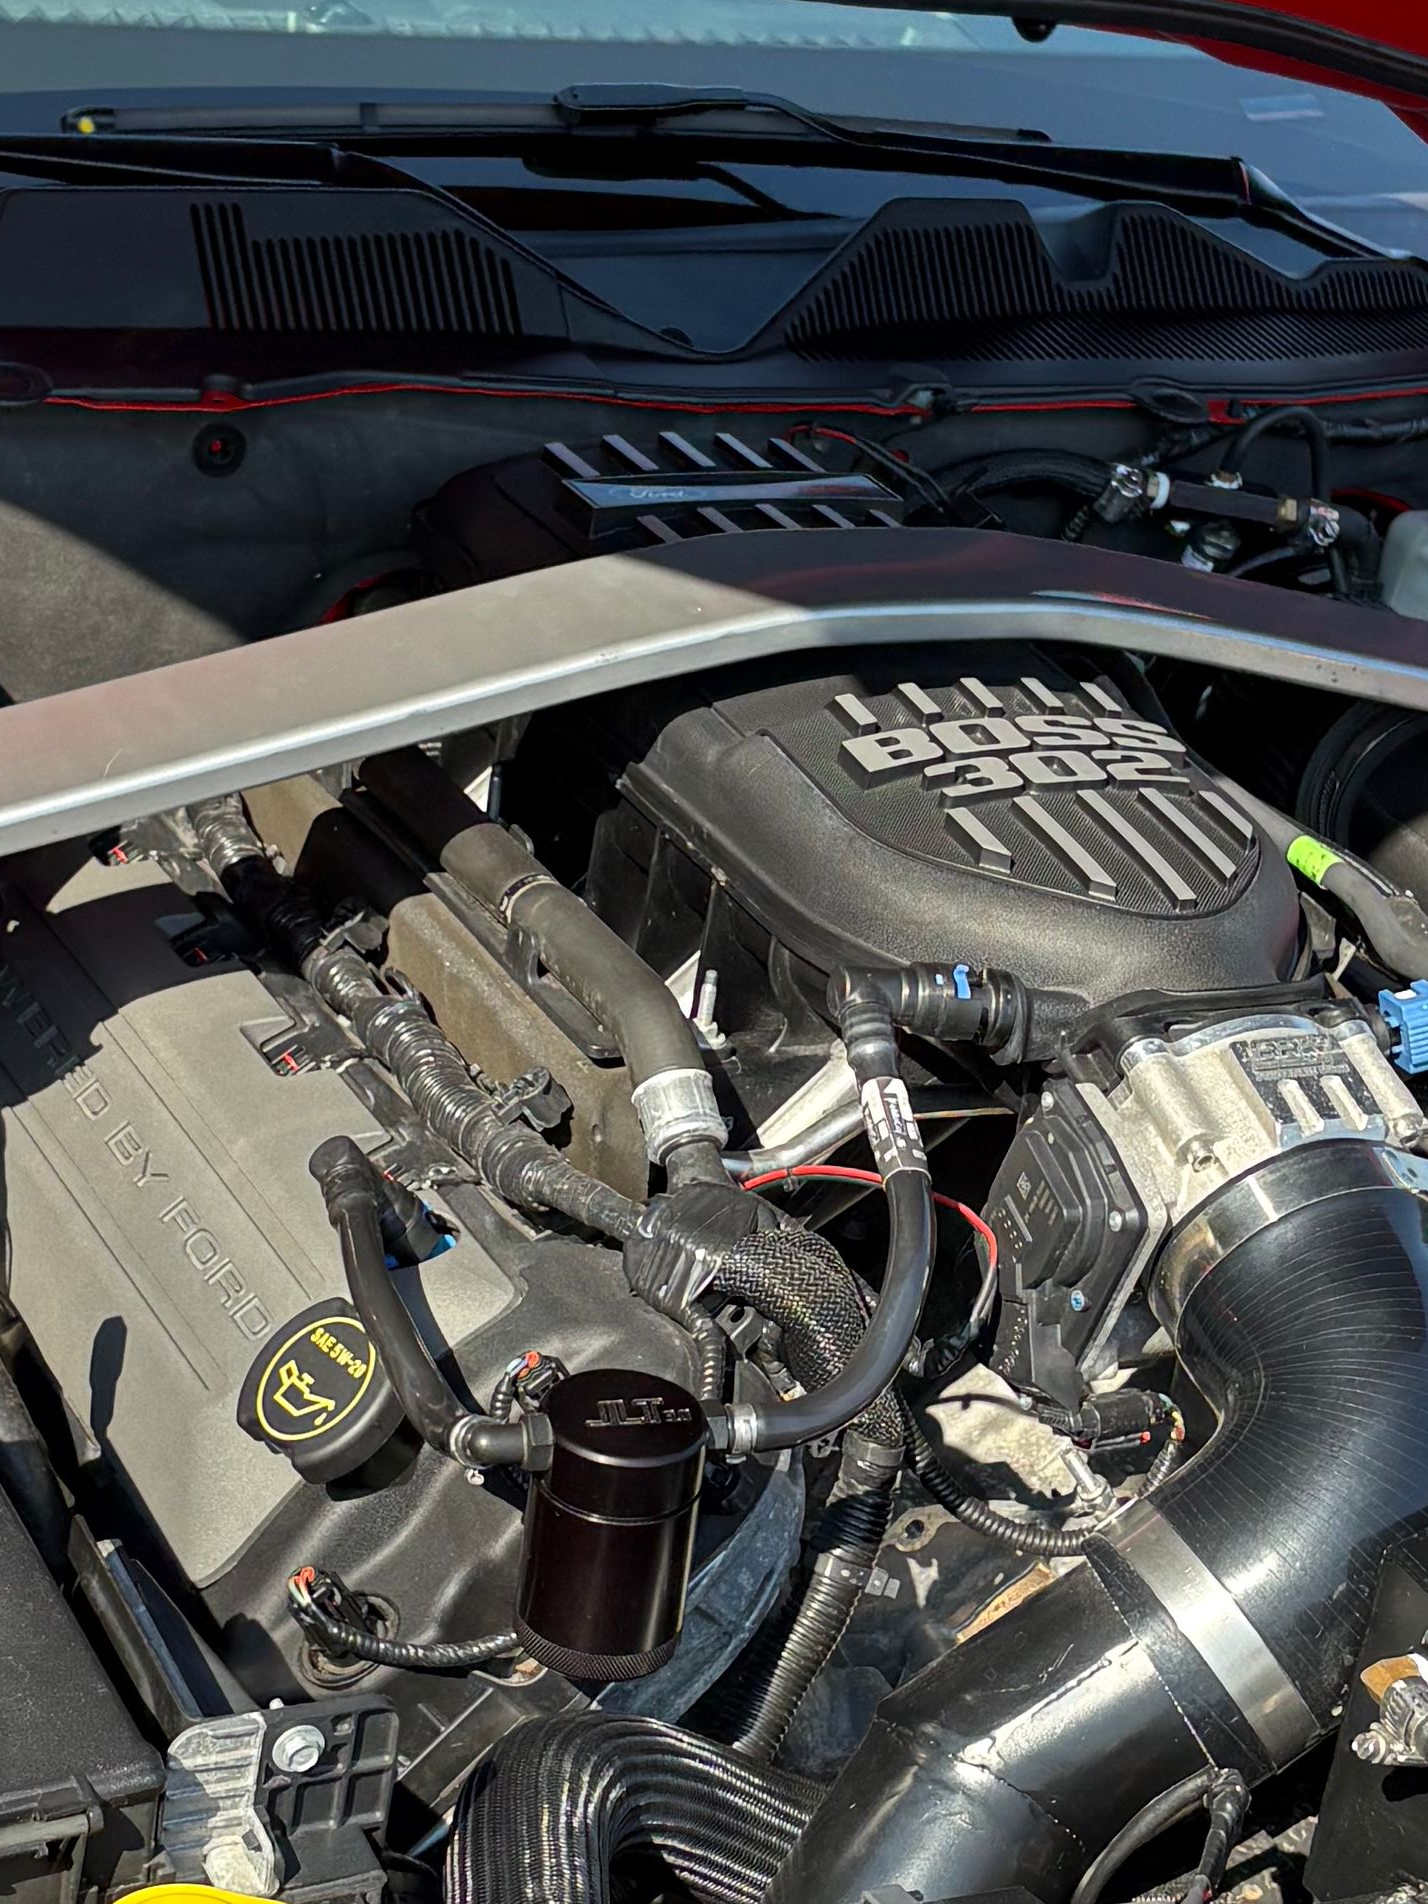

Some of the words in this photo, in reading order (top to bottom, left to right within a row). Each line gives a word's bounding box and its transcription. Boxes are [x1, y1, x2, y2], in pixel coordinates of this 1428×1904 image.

[842, 714, 1186, 773] BOSS
[924, 749, 1191, 797] 302
[105, 1120, 170, 1188] BY
[159, 1195, 273, 1342] FORD
[310, 1327, 337, 1353] SAE
[329, 1343, 367, 1379] 5W-20
[585, 1397, 664, 1427] JLT
